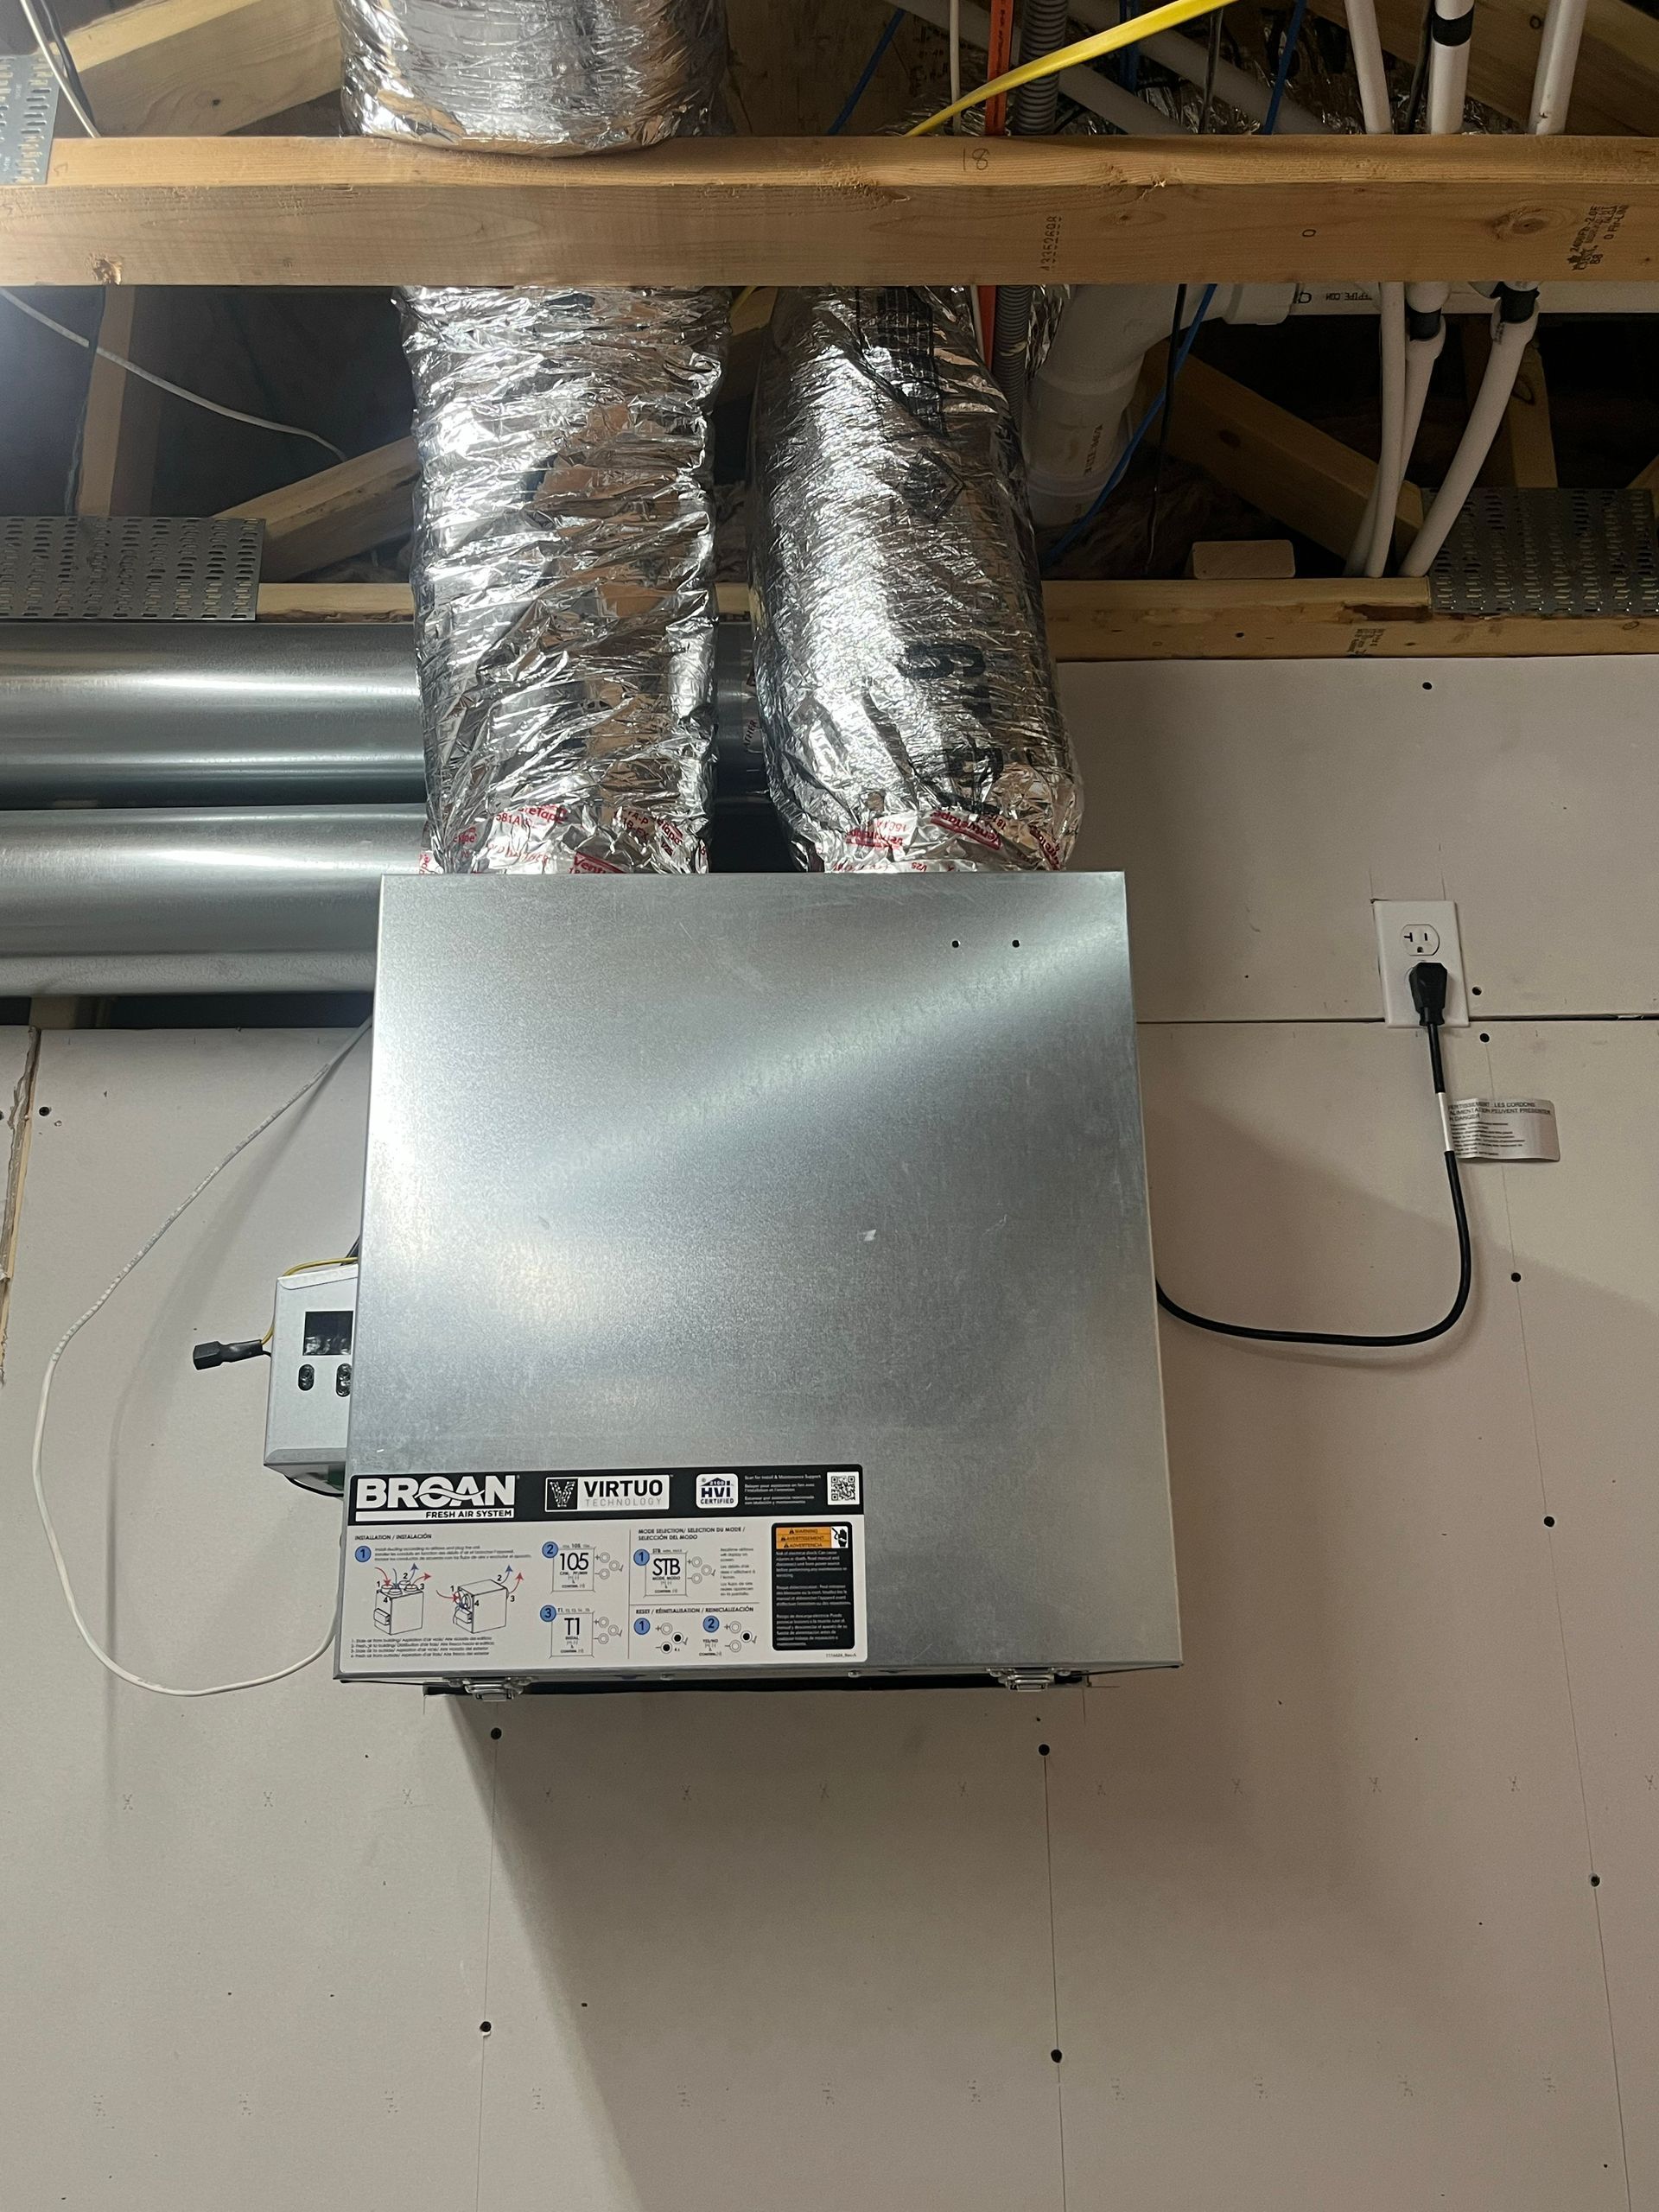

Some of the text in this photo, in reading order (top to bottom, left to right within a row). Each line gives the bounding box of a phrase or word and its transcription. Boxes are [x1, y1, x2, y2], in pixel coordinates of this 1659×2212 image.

[963, 148, 989, 170] 18
[355, 1475, 516, 1509] BROAN
[584, 1479, 663, 1497] VIRTUO
[701, 1487, 731, 1497] HVI
[586, 1497, 663, 1507] TECHNOLOGY
[560, 1553, 588, 1570] 105
[652, 1558, 681, 1576] STB
[564, 1618, 580, 1635] T1
